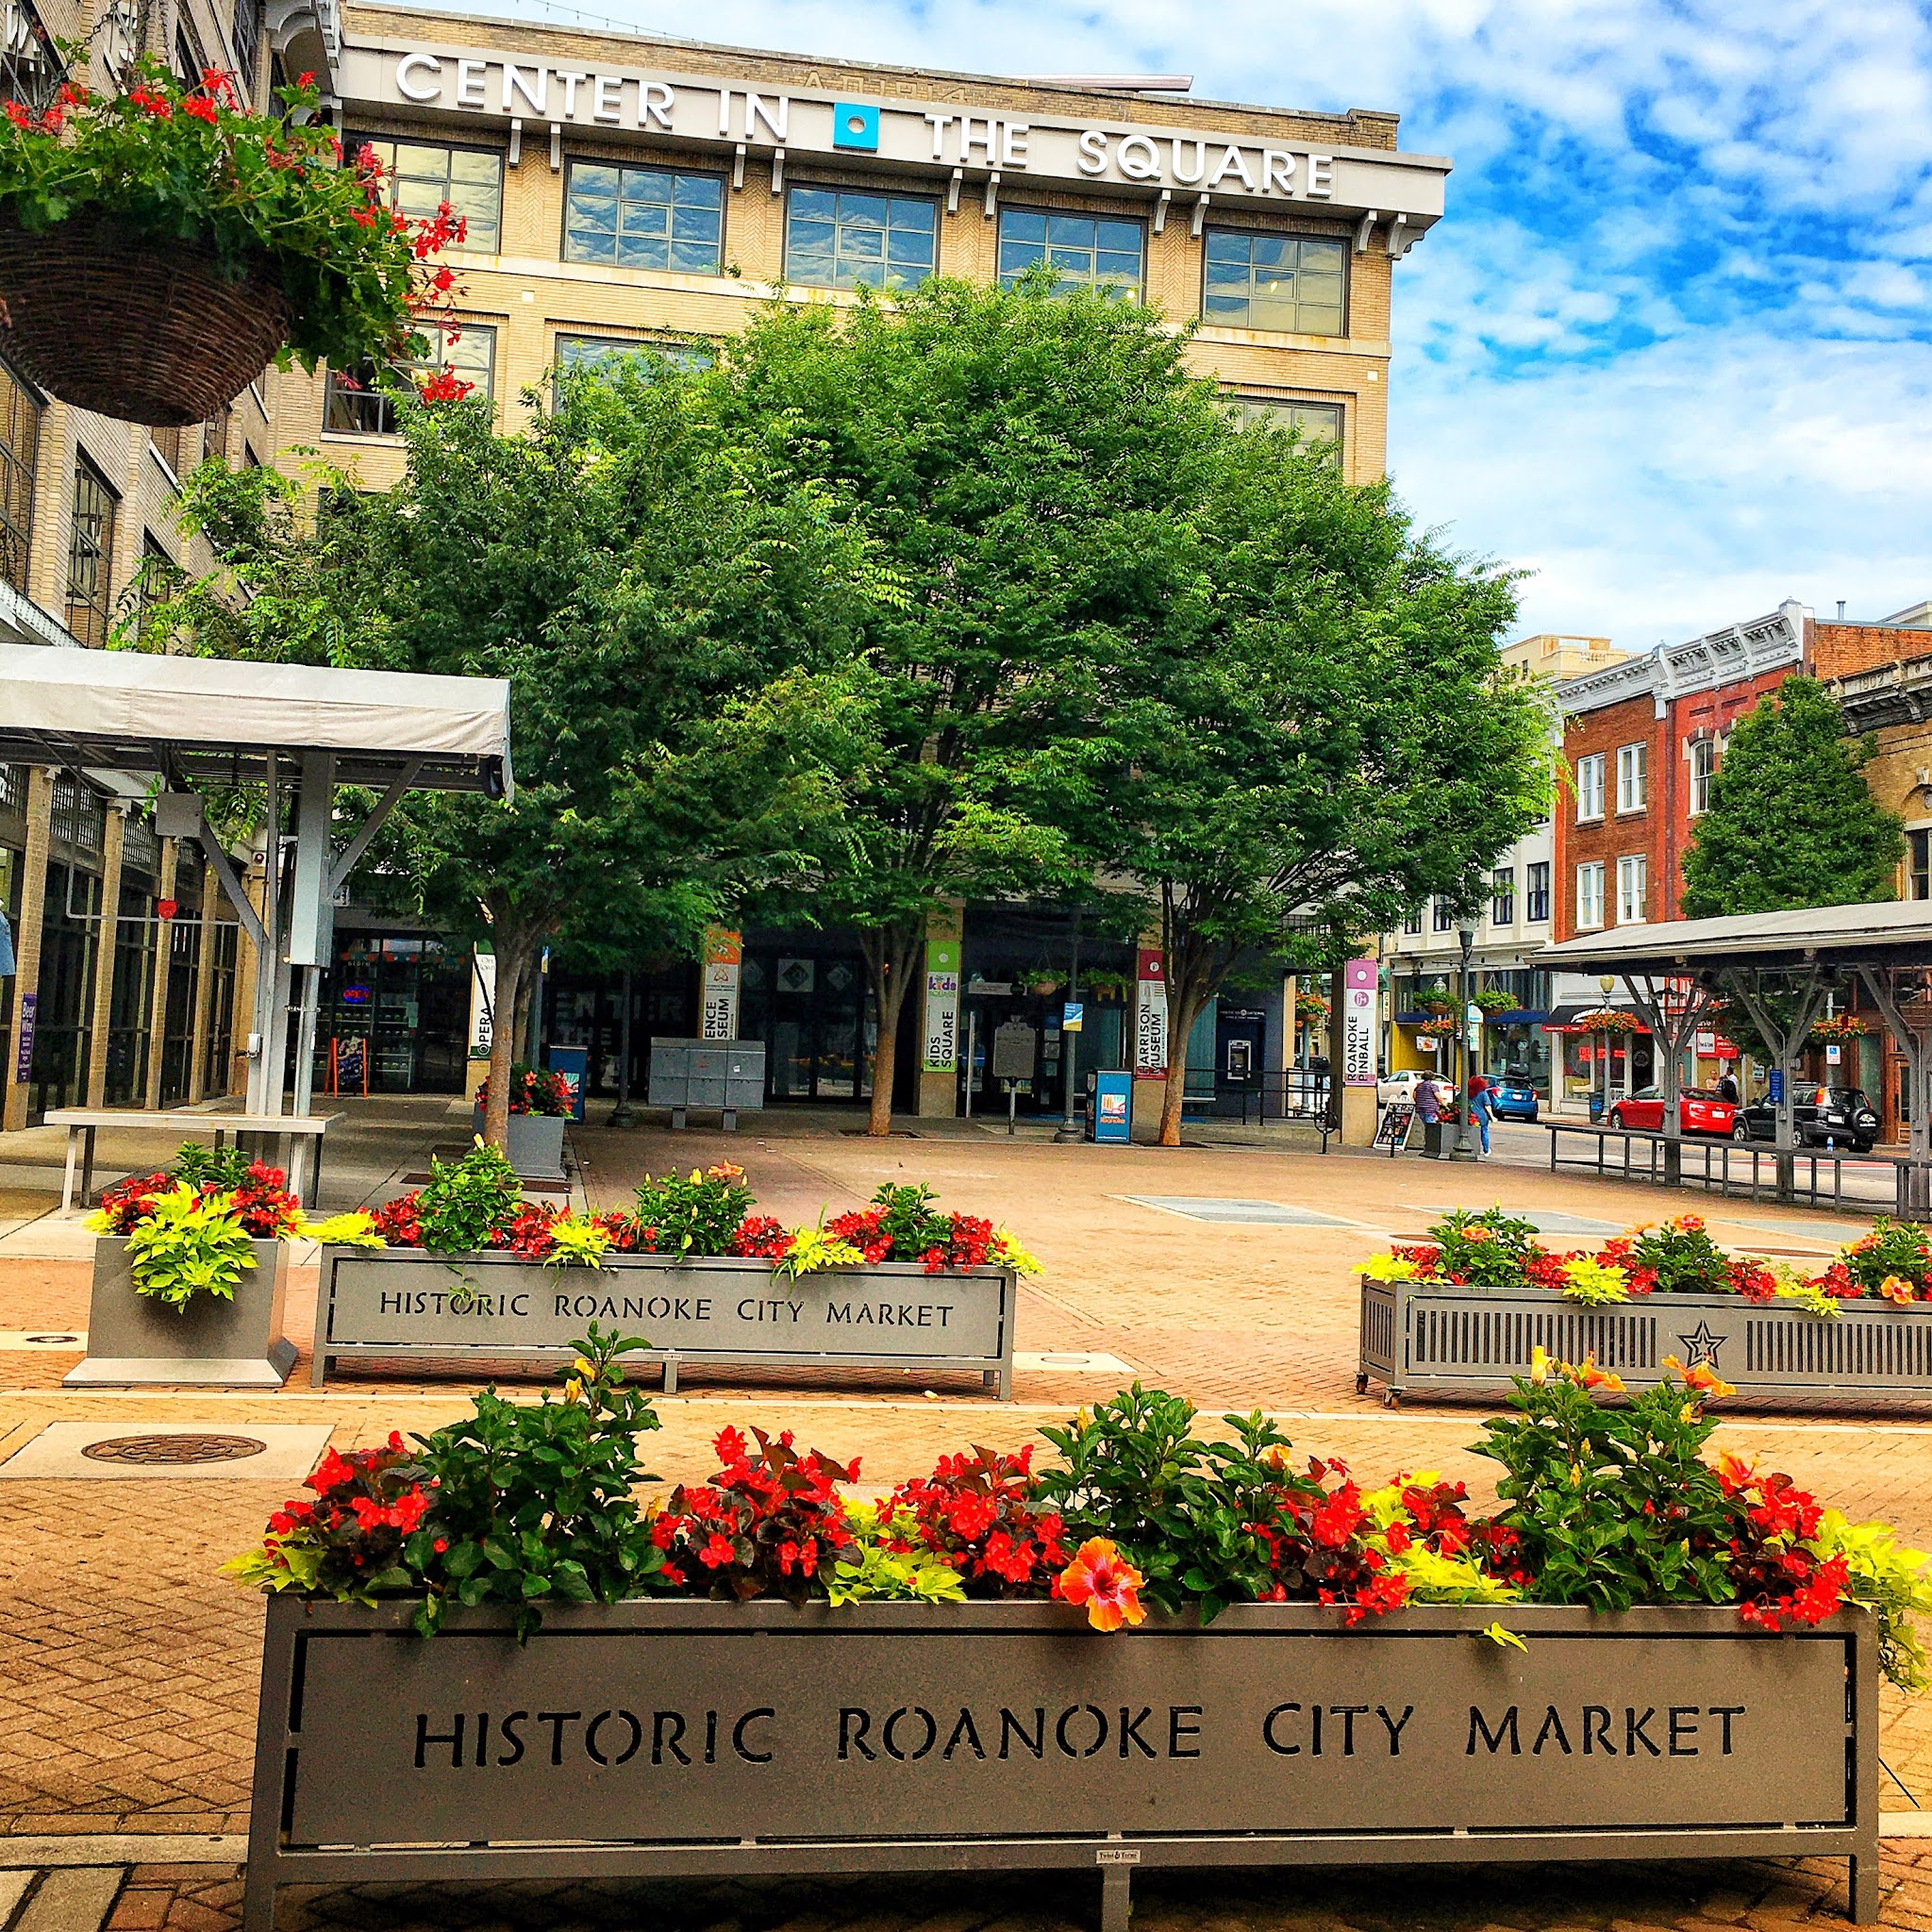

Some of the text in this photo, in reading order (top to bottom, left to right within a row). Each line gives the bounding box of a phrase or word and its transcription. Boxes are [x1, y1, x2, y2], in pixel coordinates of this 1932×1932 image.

[395, 52, 1334, 198] CENTER IN THE SQUARE
[22, 1001, 35, 1019] Beer
[928, 974, 957, 991] kids
[477, 1007, 491, 1056] OPERA
[929, 1036, 941, 1068] KIDS
[941, 1010, 954, 1069] SQUARE
[1138, 1004, 1150, 1075] HARRISON
[1150, 1013, 1161, 1075] MUSEUM
[1347, 1016, 1357, 1081] ROANOKE
[1358, 1027, 1369, 1082] PINBALL
[379, 1291, 954, 1328] HISTORIC ROANOKE CITY MARKET
[413, 1702, 1746, 1769] HISTORIC ROANOKE CITY MARKET
